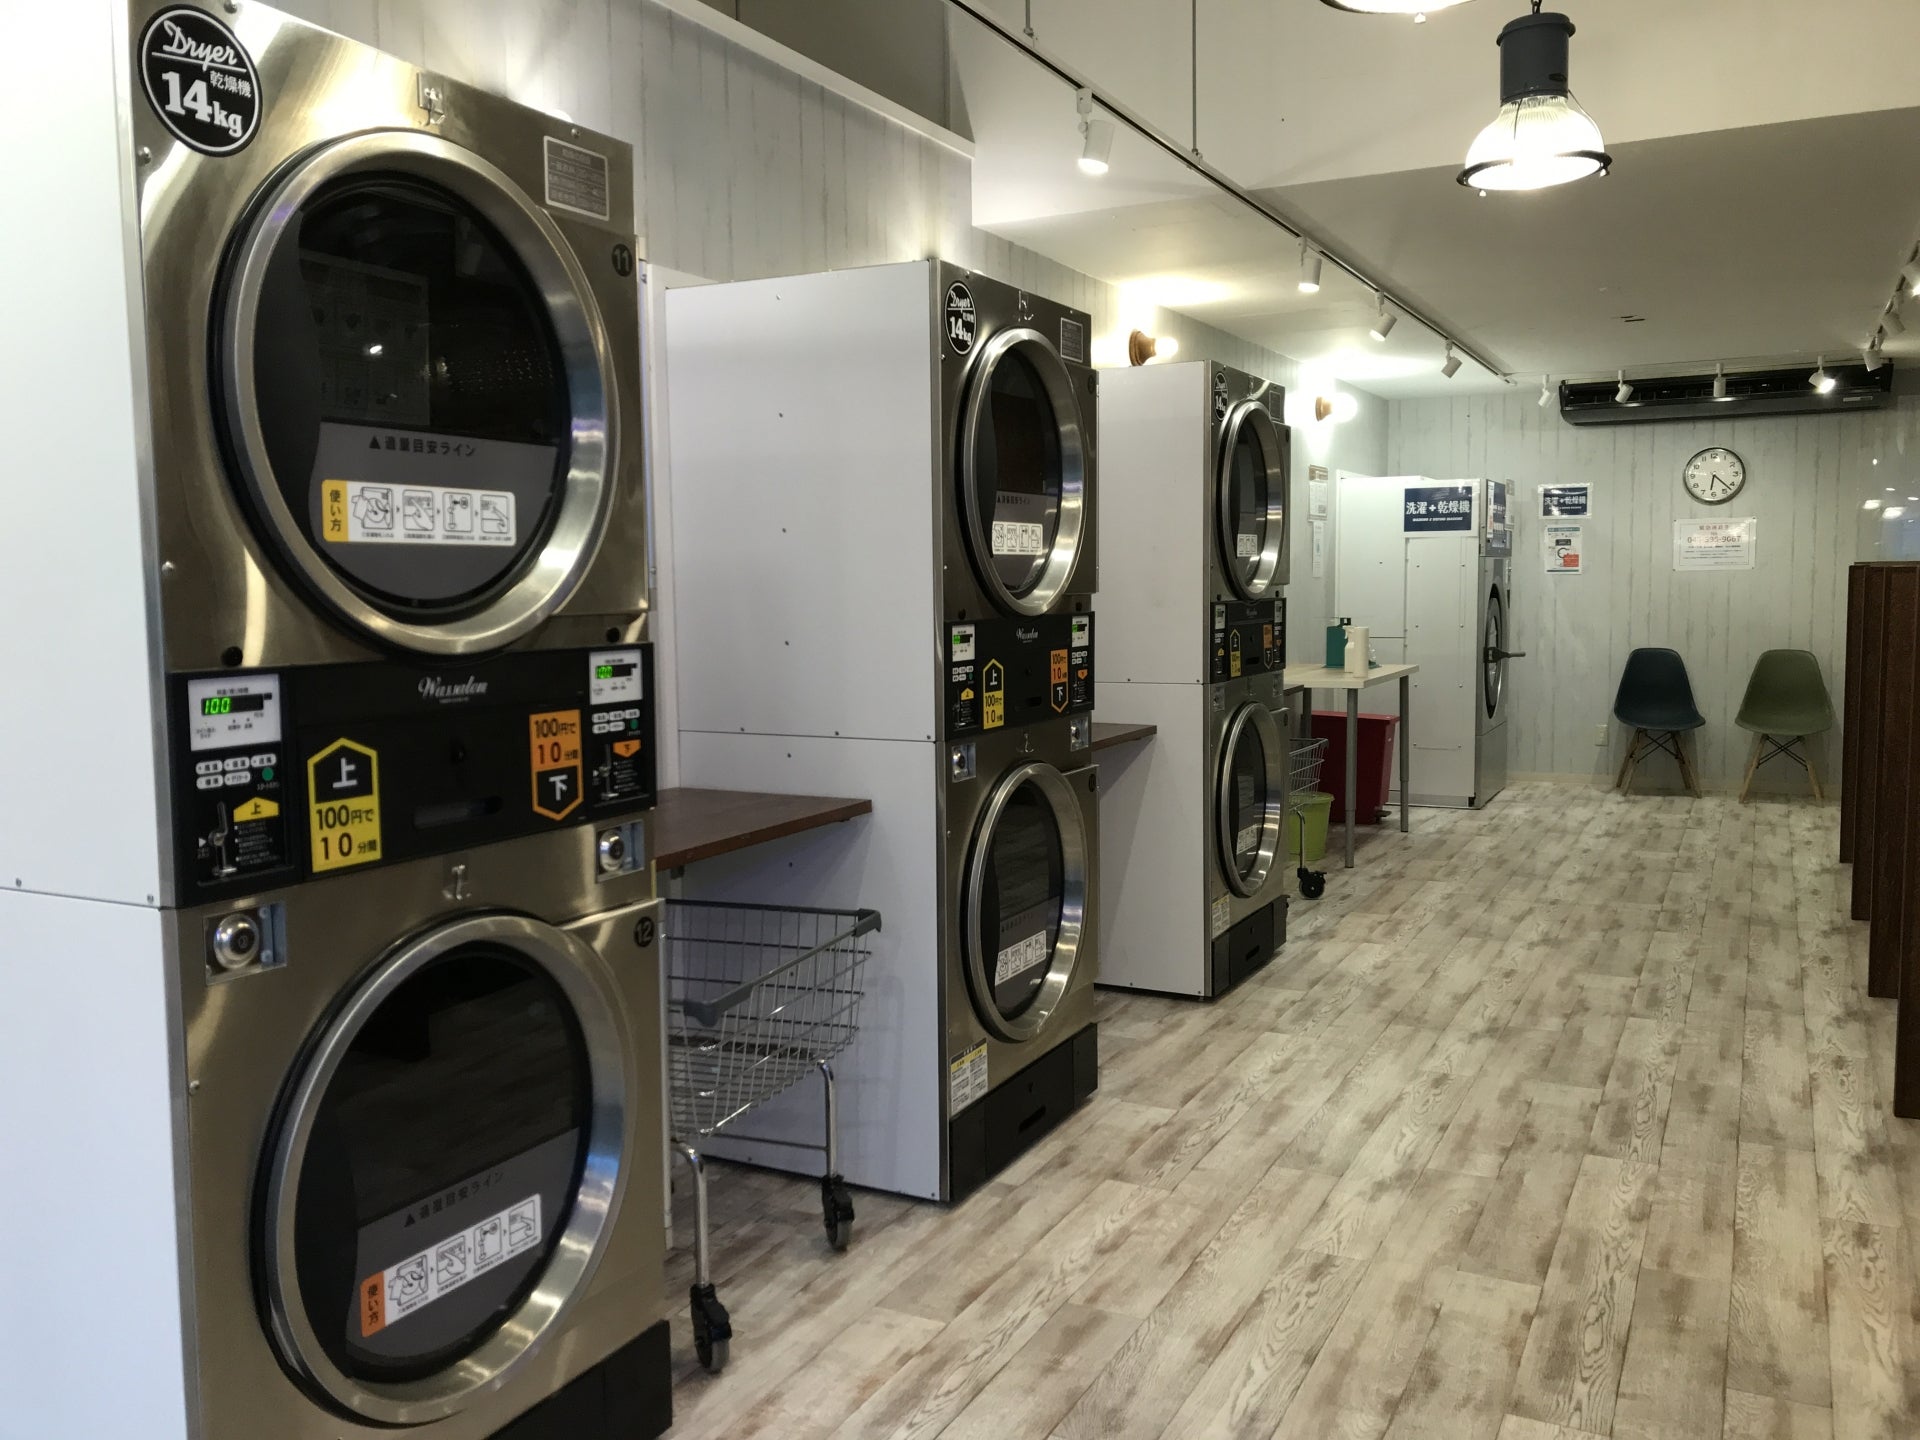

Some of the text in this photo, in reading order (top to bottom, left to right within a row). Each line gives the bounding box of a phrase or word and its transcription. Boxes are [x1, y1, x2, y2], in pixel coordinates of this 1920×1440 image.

[163, 20, 237, 72] Dryer
[210, 70, 252, 98] 乾燥機
[162, 71, 242, 137] 14kg
[614, 247, 630, 272] 11
[950, 316, 971, 346] 14kg
[330, 489, 341, 533] 使い方
[990, 668, 998, 686] 上
[205, 697, 231, 714] 100
[1056, 686, 1064, 702] 下
[534, 718, 576, 739] 100円で
[332, 757, 358, 789] 上
[549, 774, 568, 801] 下
[250, 802, 261, 815] 上
[316, 804, 374, 830] 100円で
